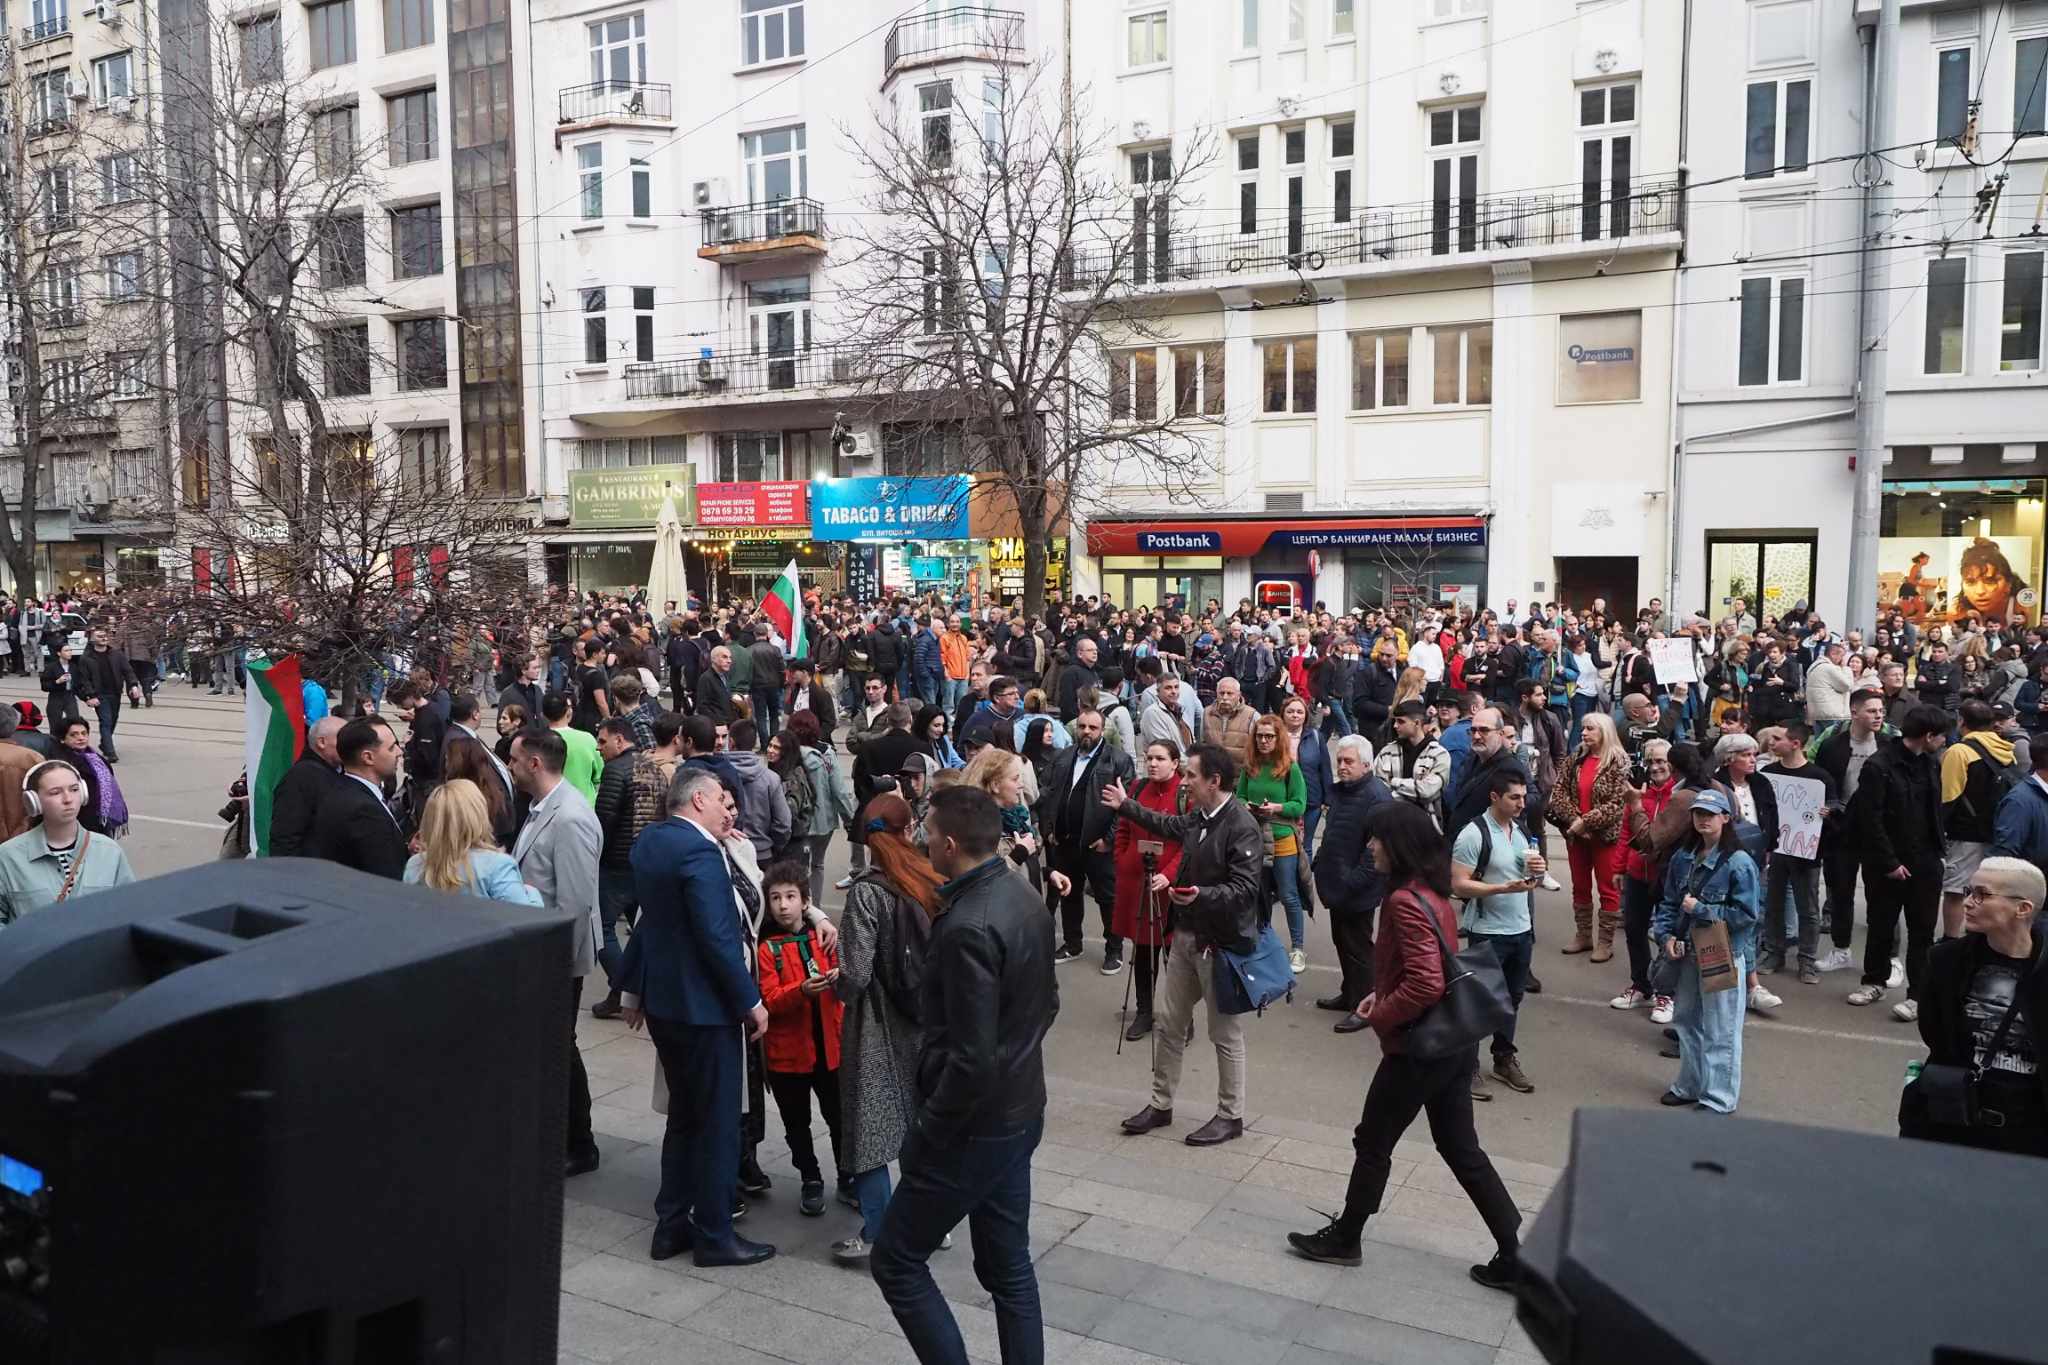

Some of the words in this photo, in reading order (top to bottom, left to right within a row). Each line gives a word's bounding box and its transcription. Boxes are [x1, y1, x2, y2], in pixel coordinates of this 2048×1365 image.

[1585, 349, 1629, 360] Postbank
[822, 506, 880, 524] TABACO
[885, 507, 896, 523] &
[708, 529, 777, 538] НОТАРИУС
[1291, 535, 1329, 545] ЦЕНТЪР
[1331, 534, 1392, 544] БАНКИРАНЕ
[1394, 533, 1434, 543] МАЛЪК
[1436, 532, 1478, 542] БИЗНЕС
[1147, 534, 1211, 547] Postbank
